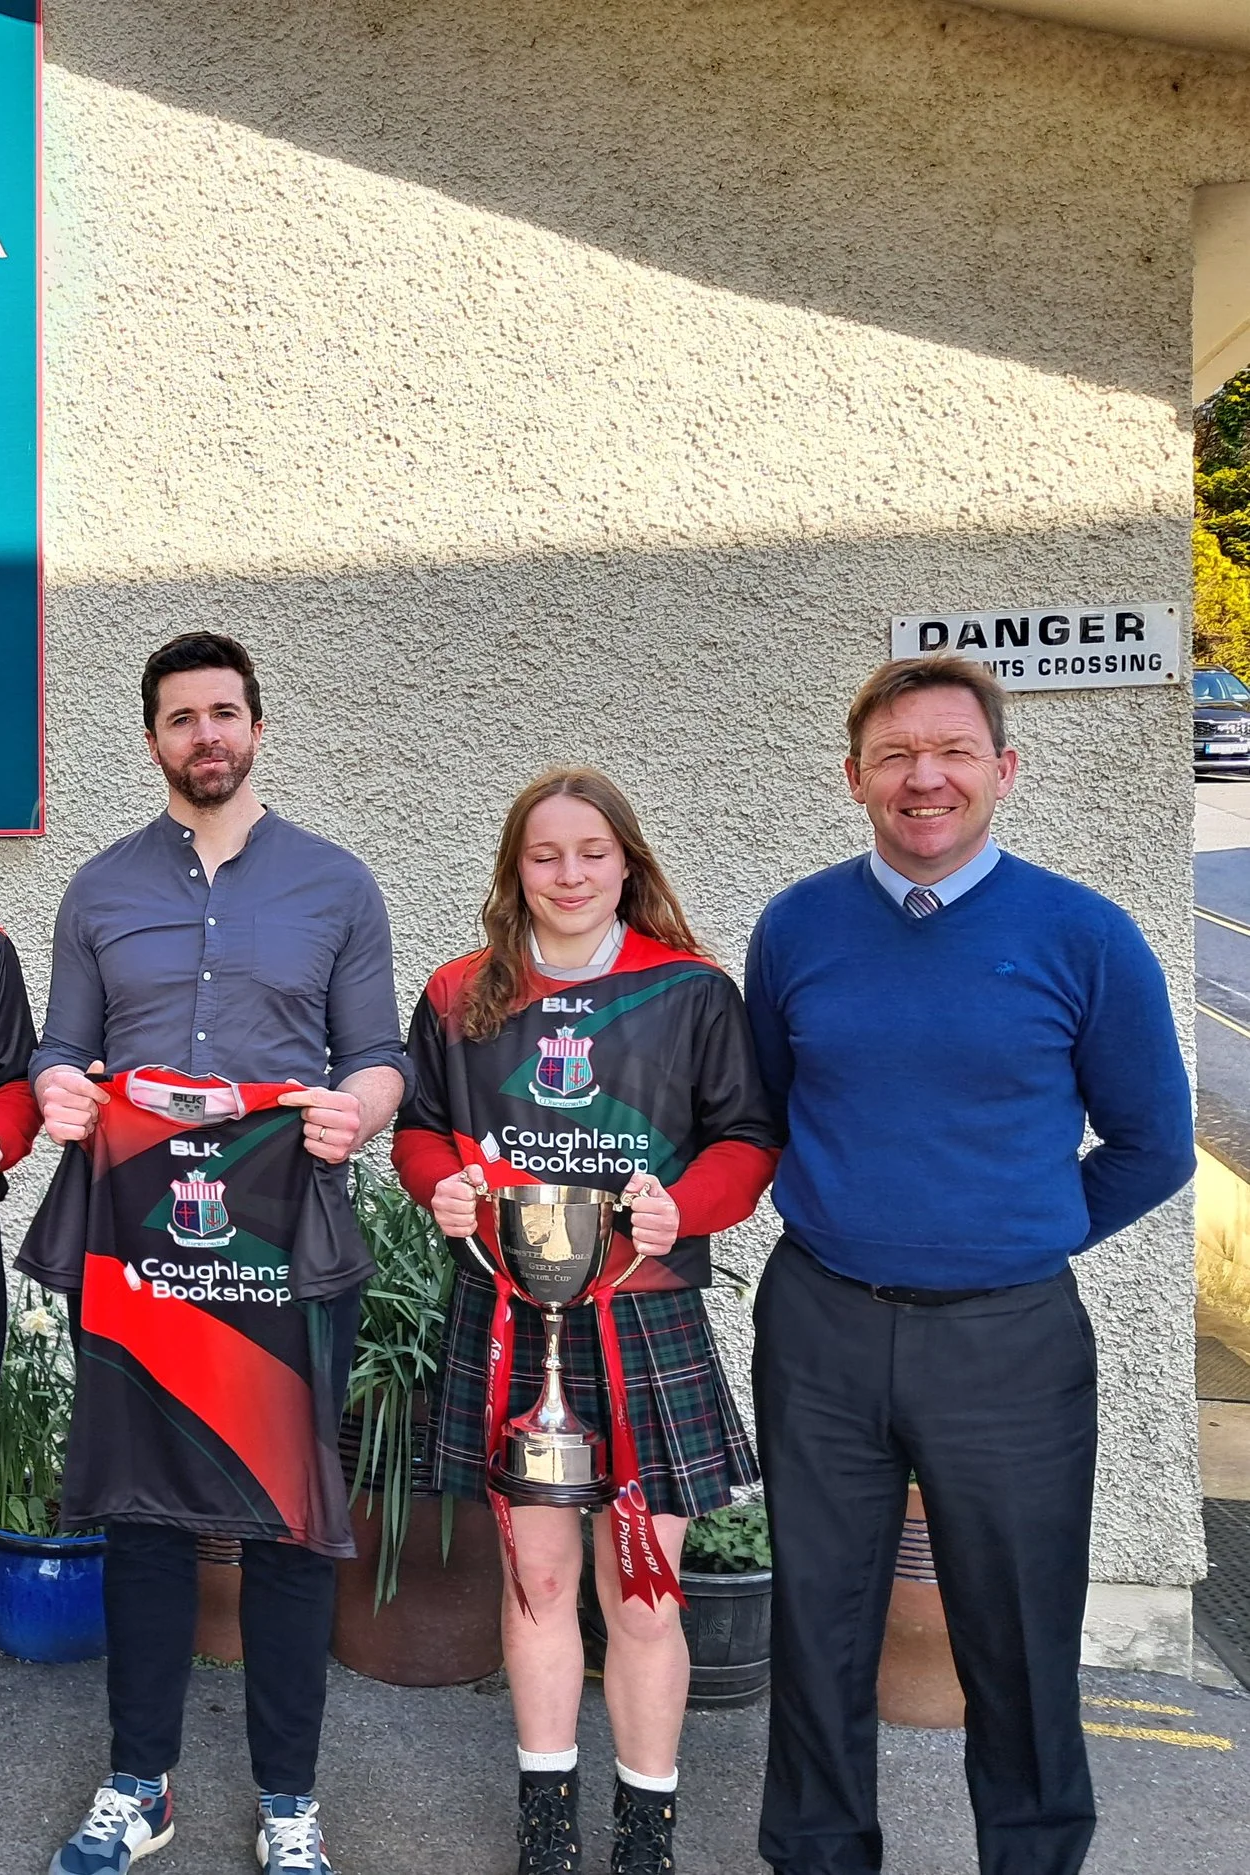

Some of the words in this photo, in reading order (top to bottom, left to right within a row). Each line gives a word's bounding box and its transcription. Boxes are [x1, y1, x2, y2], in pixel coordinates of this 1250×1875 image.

[918, 611, 1146, 652] DANGER
[1037, 653, 1163, 677] CROSSING
[541, 997, 594, 1014] BLK
[172, 1093, 203, 1105] BLK
[169, 1139, 224, 1158] BLK
[501, 1125, 649, 1155] Coughlans
[510, 1149, 649, 1174] Bookshop
[141, 1257, 290, 1285] Coughlans
[152, 1280, 292, 1307] Bookshop
[618, 1519, 635, 1579] Pinergy
[635, 1514, 663, 1576] Pinergy
